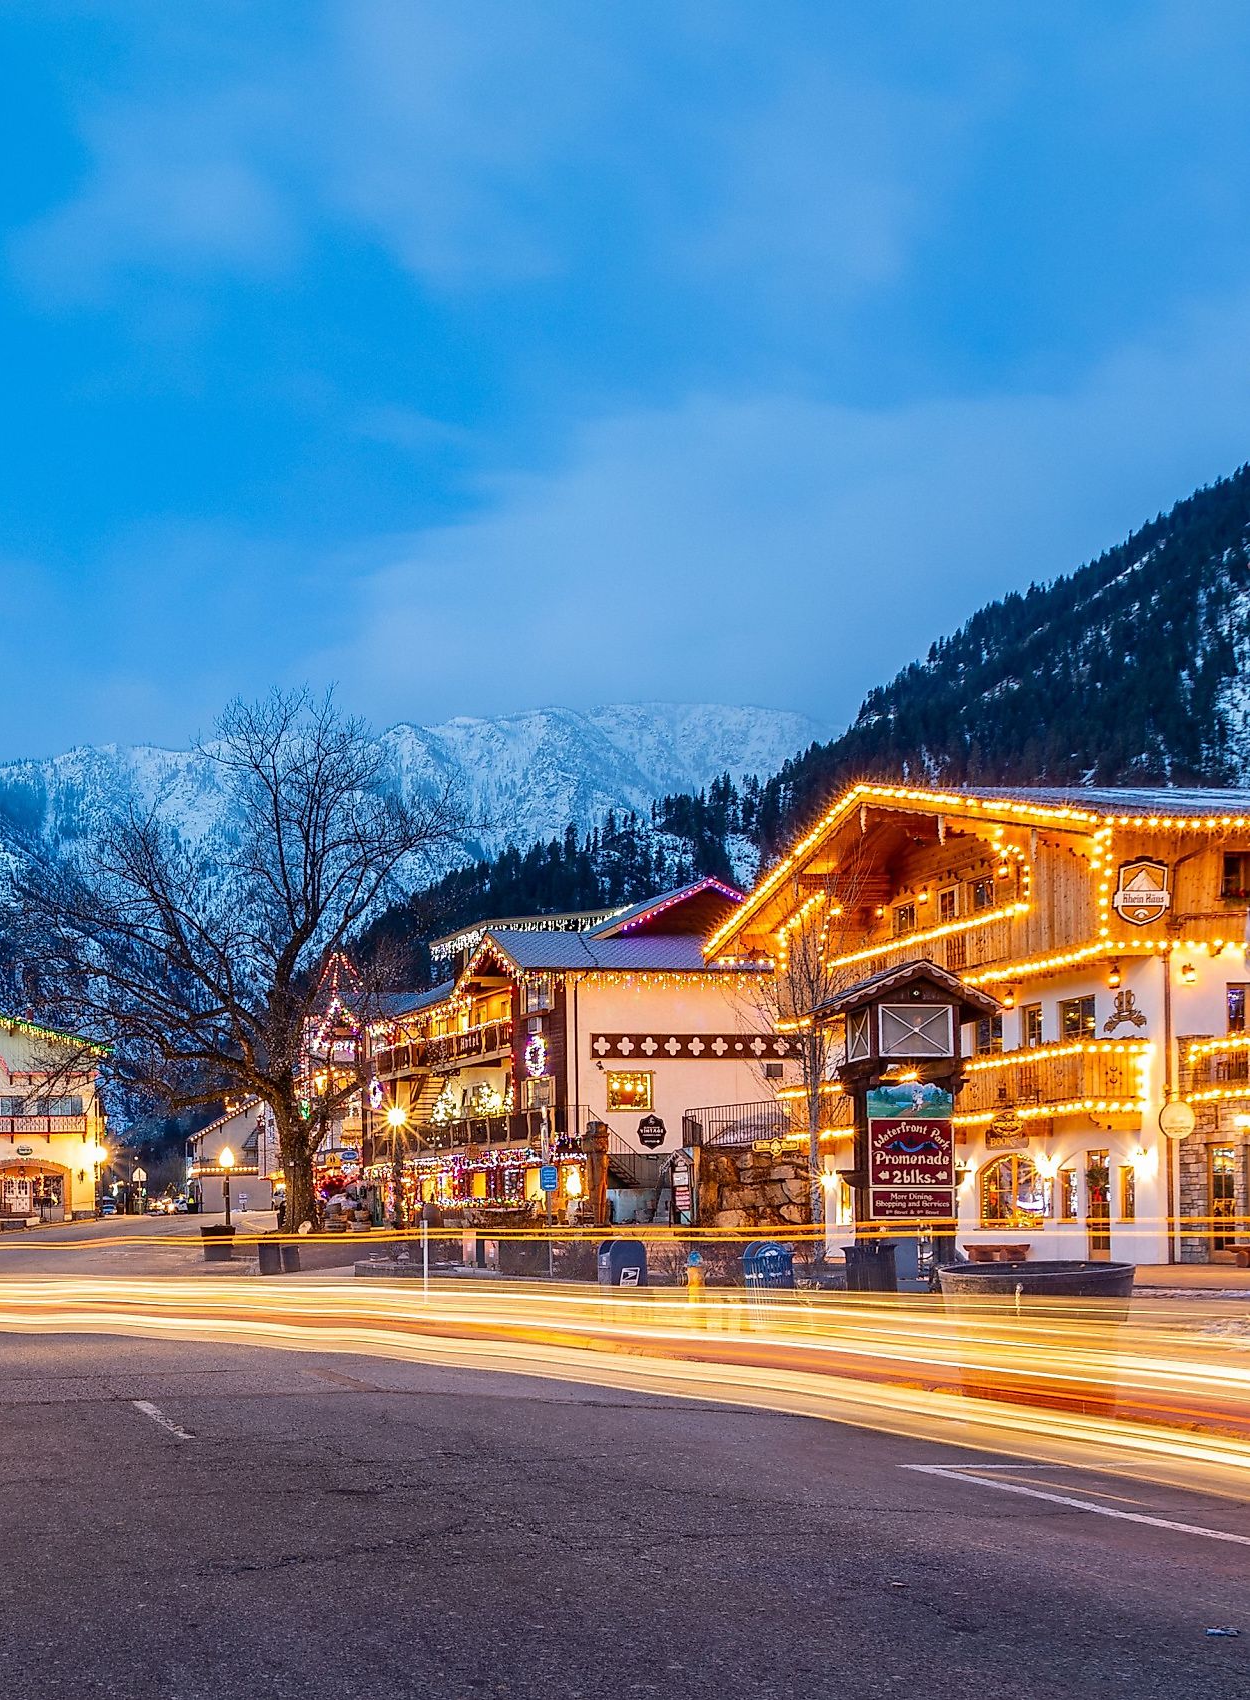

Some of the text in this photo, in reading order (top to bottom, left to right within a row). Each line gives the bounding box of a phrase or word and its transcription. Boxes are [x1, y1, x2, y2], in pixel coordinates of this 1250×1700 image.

[873, 1121, 950, 1150] Waterfront Park
[873, 1150, 950, 1165] Promenade
[875, 1200, 907, 1208] Shopping
